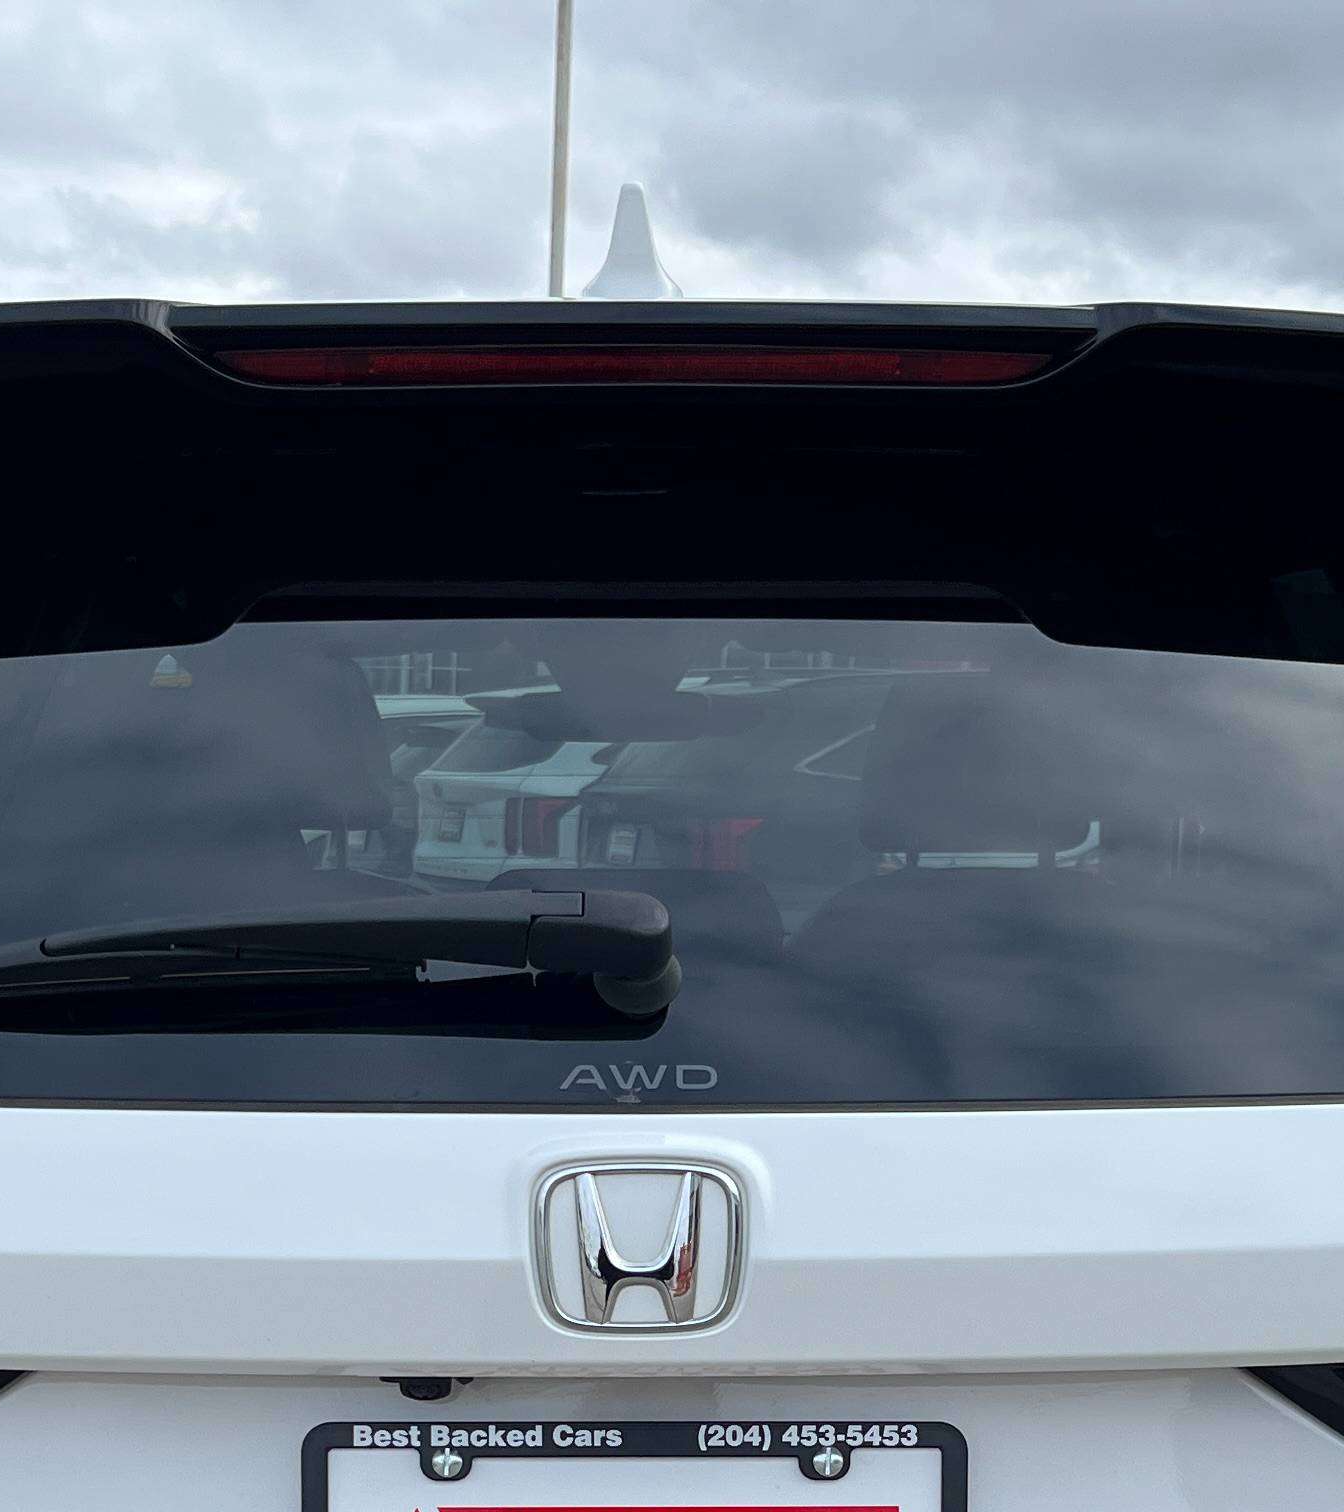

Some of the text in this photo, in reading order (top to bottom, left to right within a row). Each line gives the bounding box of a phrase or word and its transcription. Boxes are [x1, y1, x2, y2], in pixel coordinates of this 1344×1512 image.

[559, 1063, 718, 1090] AWD
[353, 1424, 918, 1451] Best Backed Cars (204) 453-5453
